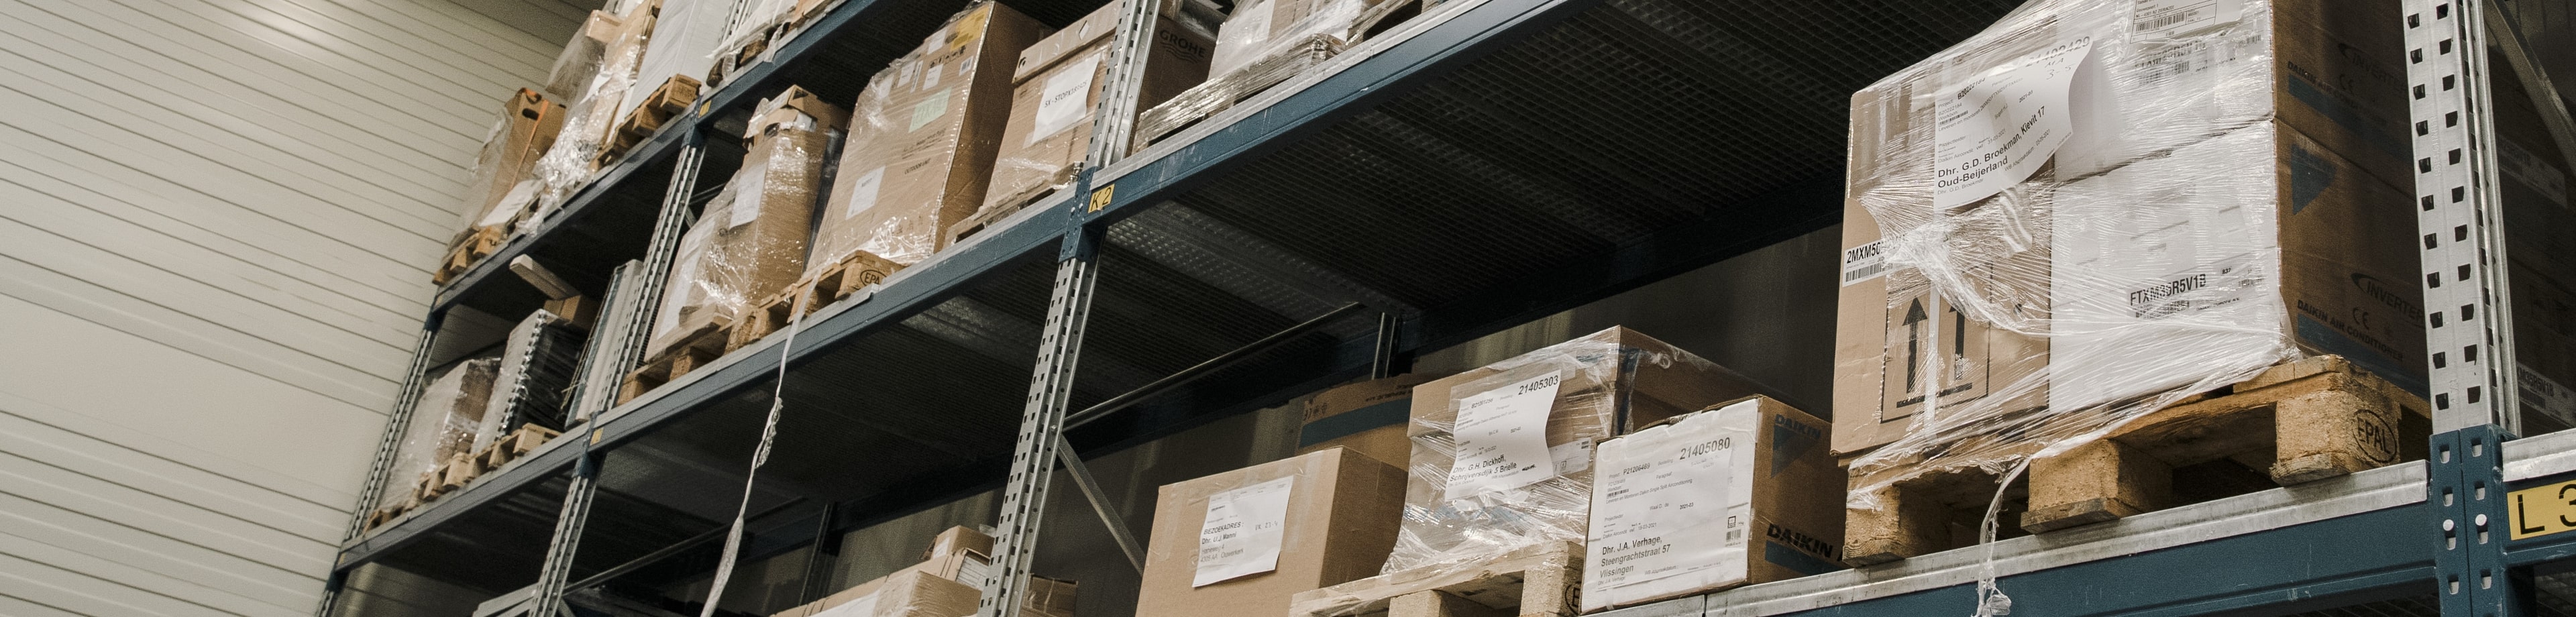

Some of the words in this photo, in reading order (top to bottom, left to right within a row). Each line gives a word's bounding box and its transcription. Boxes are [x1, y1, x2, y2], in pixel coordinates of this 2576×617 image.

[1159, 29, 1206, 58] GROHE
[1938, 166, 1960, 178] Dhr.
[1962, 158, 1981, 171] G.D.
[1984, 133, 2023, 163] Broekman,
[2021, 114, 2037, 135] Kievit
[2037, 105, 2045, 119] 17
[1938, 155, 2008, 188] Oud-Beijerland
[1091, 191, 1102, 211] K
[1102, 186, 1112, 206] 2
[2297, 299, 2328, 323] DAIKIN
[2329, 317, 2345, 332] AIR
[2347, 326, 2404, 362] CONDITIONER
[1518, 374, 1559, 395] 21405303
[1775, 413, 1821, 439] DAIKIN
[2356, 416, 2391, 454] EPAL
[1679, 437, 1731, 460] 21405080
[1450, 469, 1493, 483] Schrijversdijk
[1499, 461, 1517, 473] Brielle
[1468, 463, 1482, 471] G.H.
[1483, 453, 1507, 467] Dickhoff,
[1668, 478, 1693, 488] Airconditioning
[2517, 494, 2545, 535] L
[2559, 484, 2576, 527] 3
[1201, 537, 1212, 545] Dhr.
[1602, 545, 1616, 555] Dhr.
[1617, 541, 1631, 553] J.A.
[1632, 536, 1663, 549] Verhage,
[1766, 522, 1834, 559] DAIKIN
[1601, 547, 1660, 567] Steengrachtstraat
[1662, 544, 1671, 554] 57
[1599, 565, 1634, 579] Vlissingen
